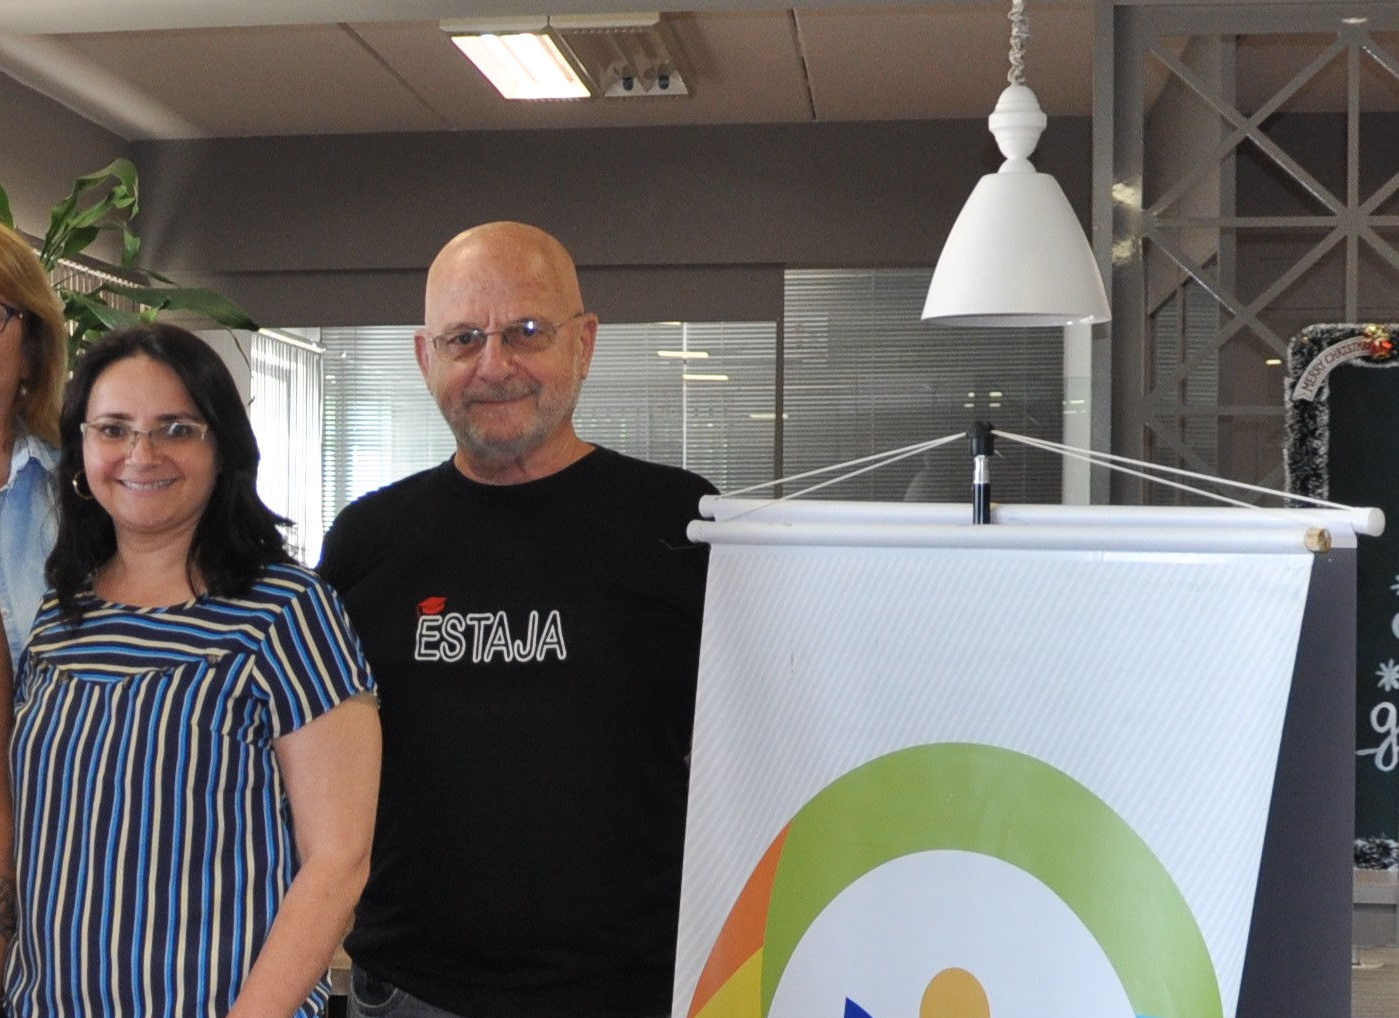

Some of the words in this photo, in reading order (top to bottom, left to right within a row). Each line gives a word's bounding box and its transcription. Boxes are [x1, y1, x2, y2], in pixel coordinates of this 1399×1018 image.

[1301, 360, 1325, 393] MERRY
[1324, 341, 1371, 364] CHRISTM
[414, 611, 567, 663] ESTAJA
